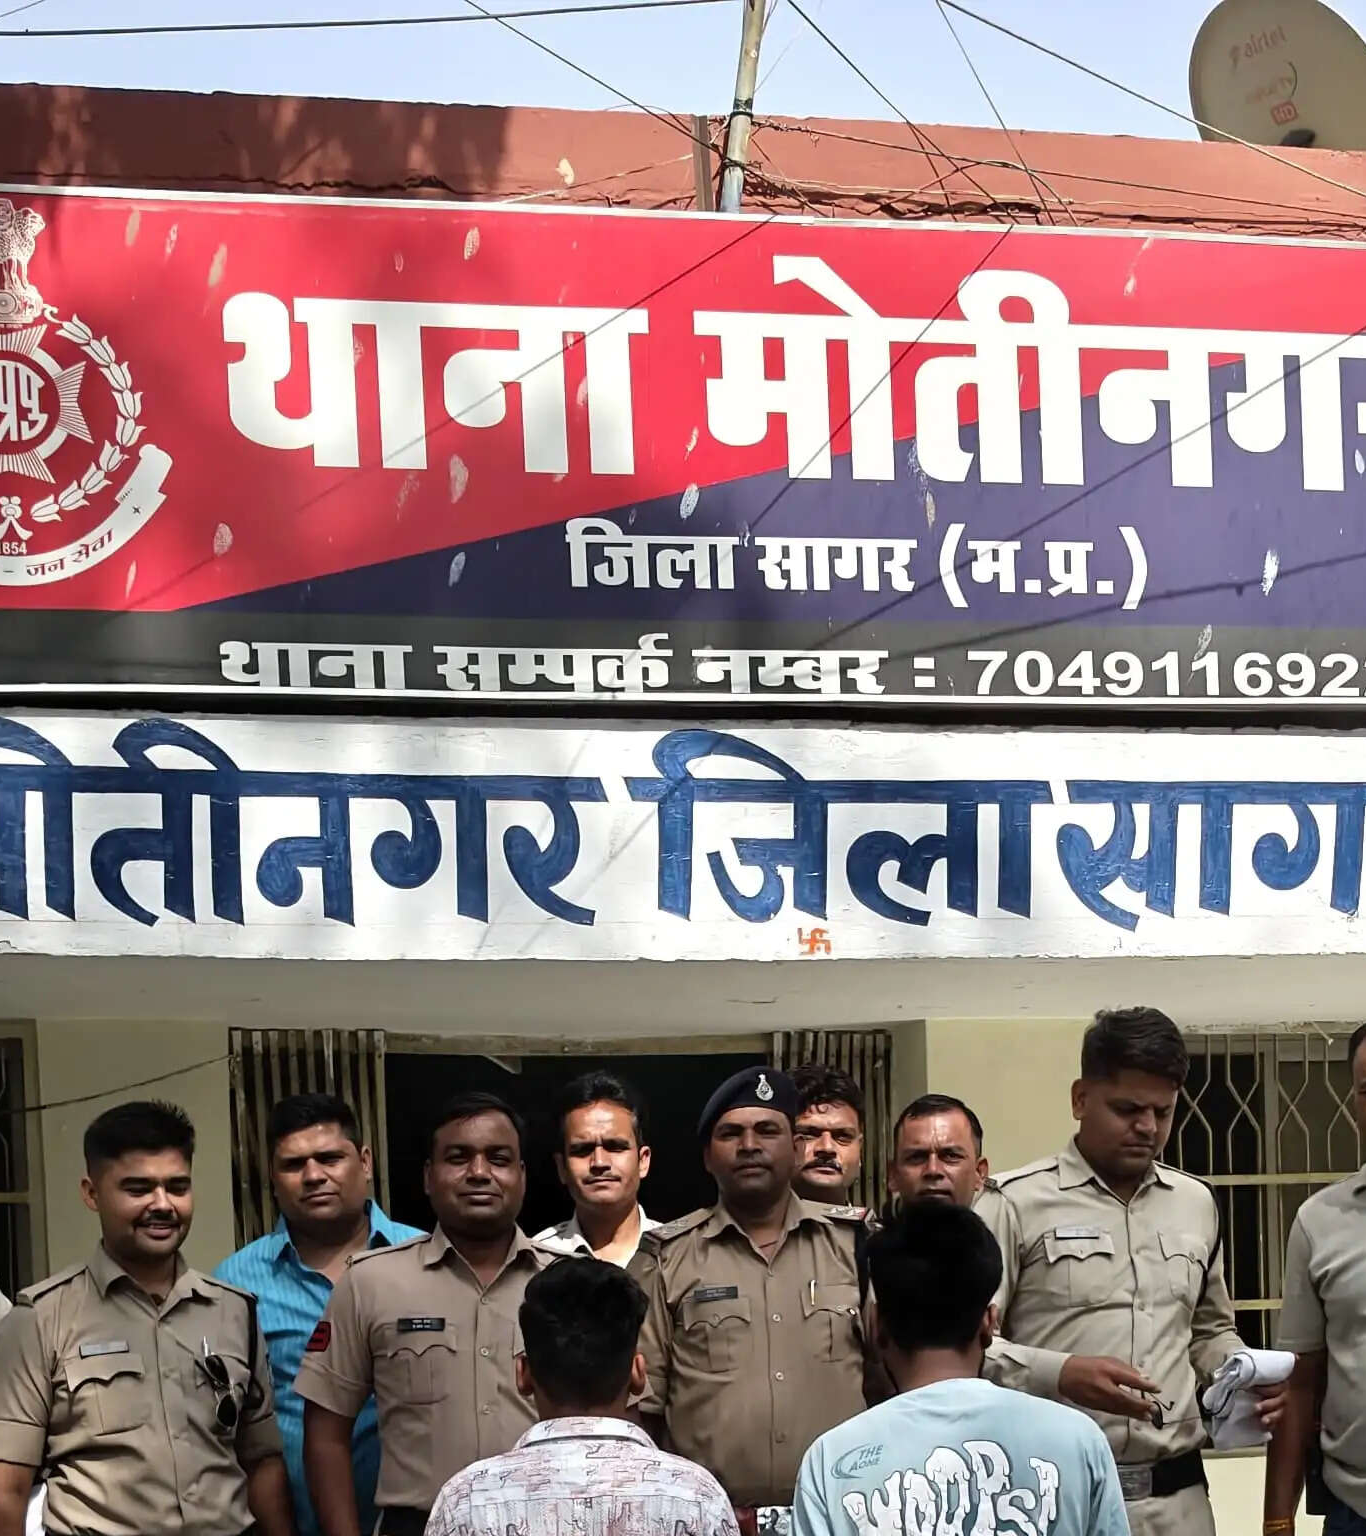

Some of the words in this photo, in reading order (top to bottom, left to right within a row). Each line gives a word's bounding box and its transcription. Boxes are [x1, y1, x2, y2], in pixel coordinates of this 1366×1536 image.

[222, 291, 650, 475] थाना
[26, 557, 68, 576] जन
[69, 527, 115, 563] सेवा
[566, 517, 740, 591] जिला
[754, 536, 918, 592] सागर
[938, 522, 1148, 610] (म.प्र.)
[219, 640, 413, 691] थाना
[433, 632, 673, 694] सम्पर्क
[693, 647, 889, 696] नम्बर
[623, 728, 1053, 924] जिला
[858, 1444, 883, 1460] THE
